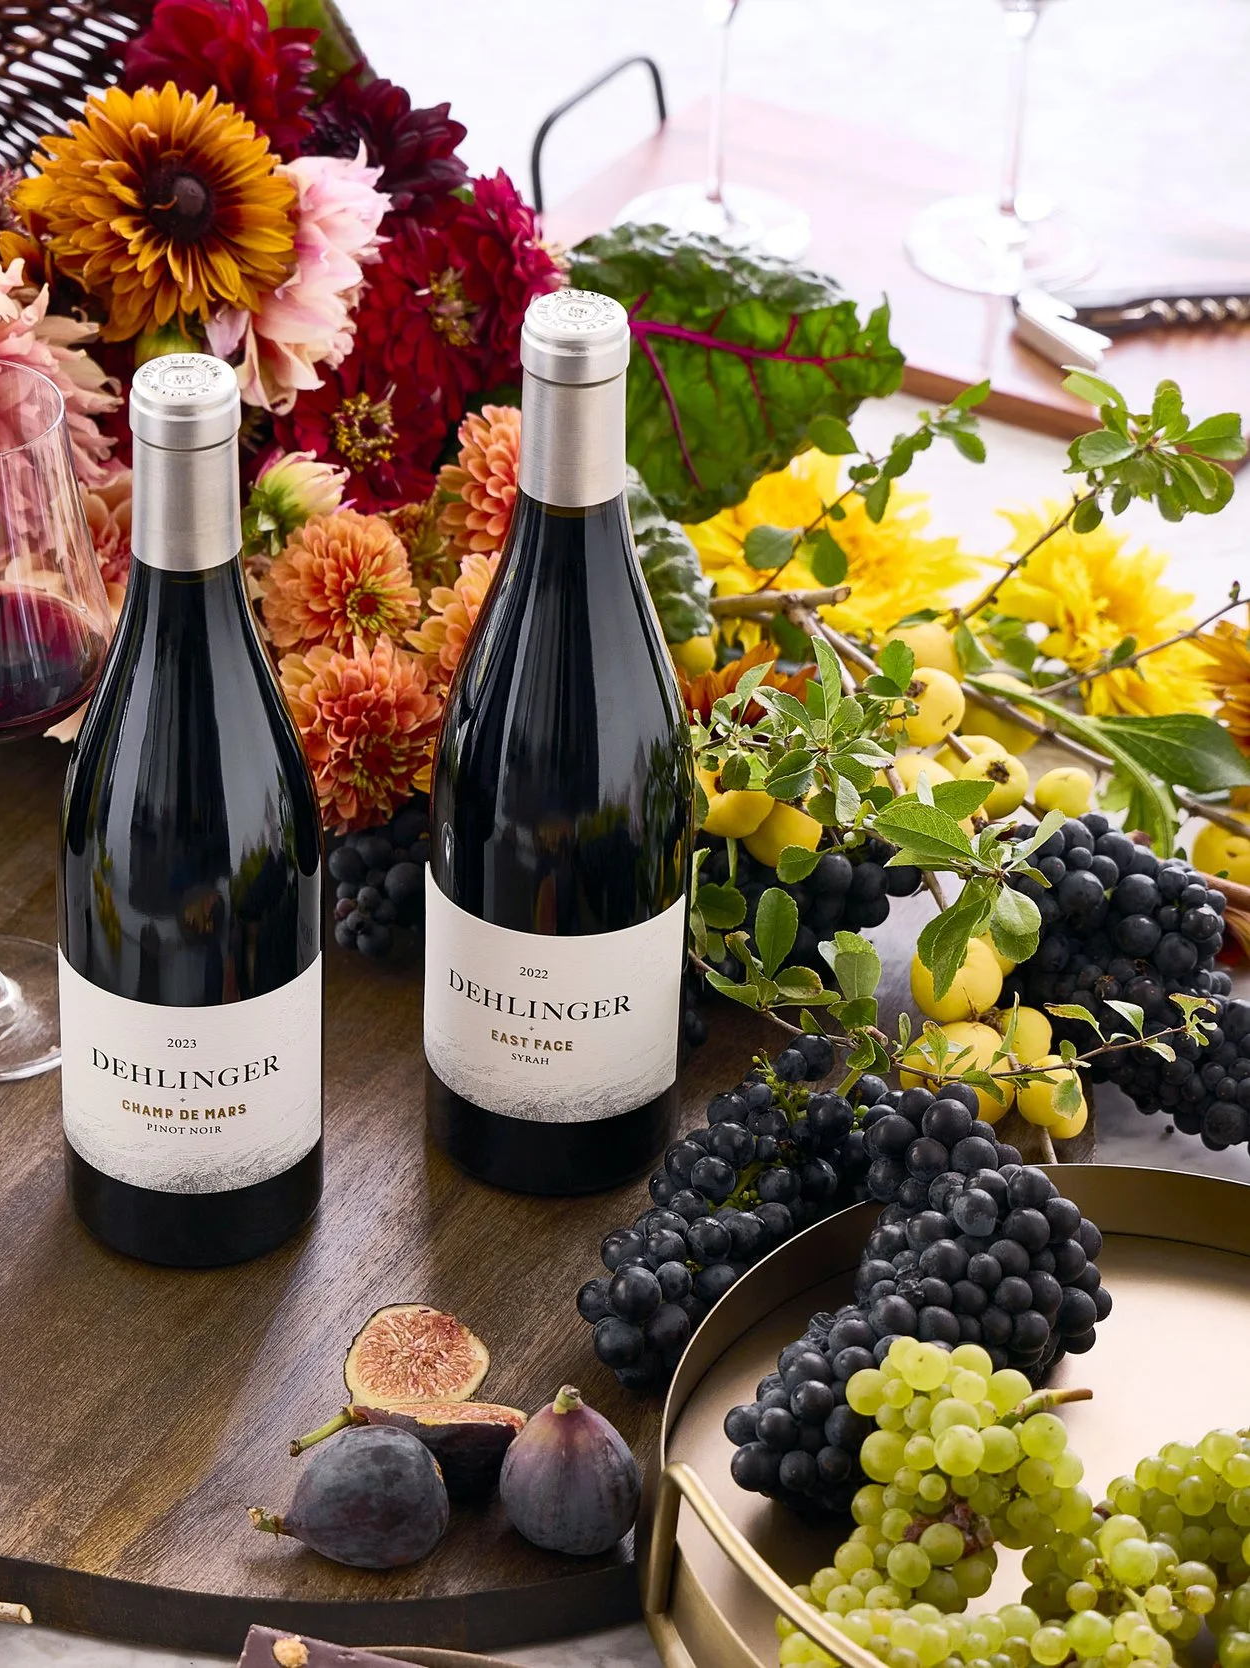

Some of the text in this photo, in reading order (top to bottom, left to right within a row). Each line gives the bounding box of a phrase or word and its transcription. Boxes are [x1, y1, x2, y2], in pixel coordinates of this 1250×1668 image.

[519, 966, 549, 980] 2022
[449, 968, 631, 1021] DEHLINGER
[167, 1038, 197, 1049] 2023
[491, 1029, 574, 1051] EAST FACE
[511, 1053, 549, 1065] SYRAH
[91, 1047, 280, 1090] DEHLINGER
[122, 1099, 247, 1120] CHAMP DE MARS
[147, 1123, 222, 1135] PINOT NOIR
